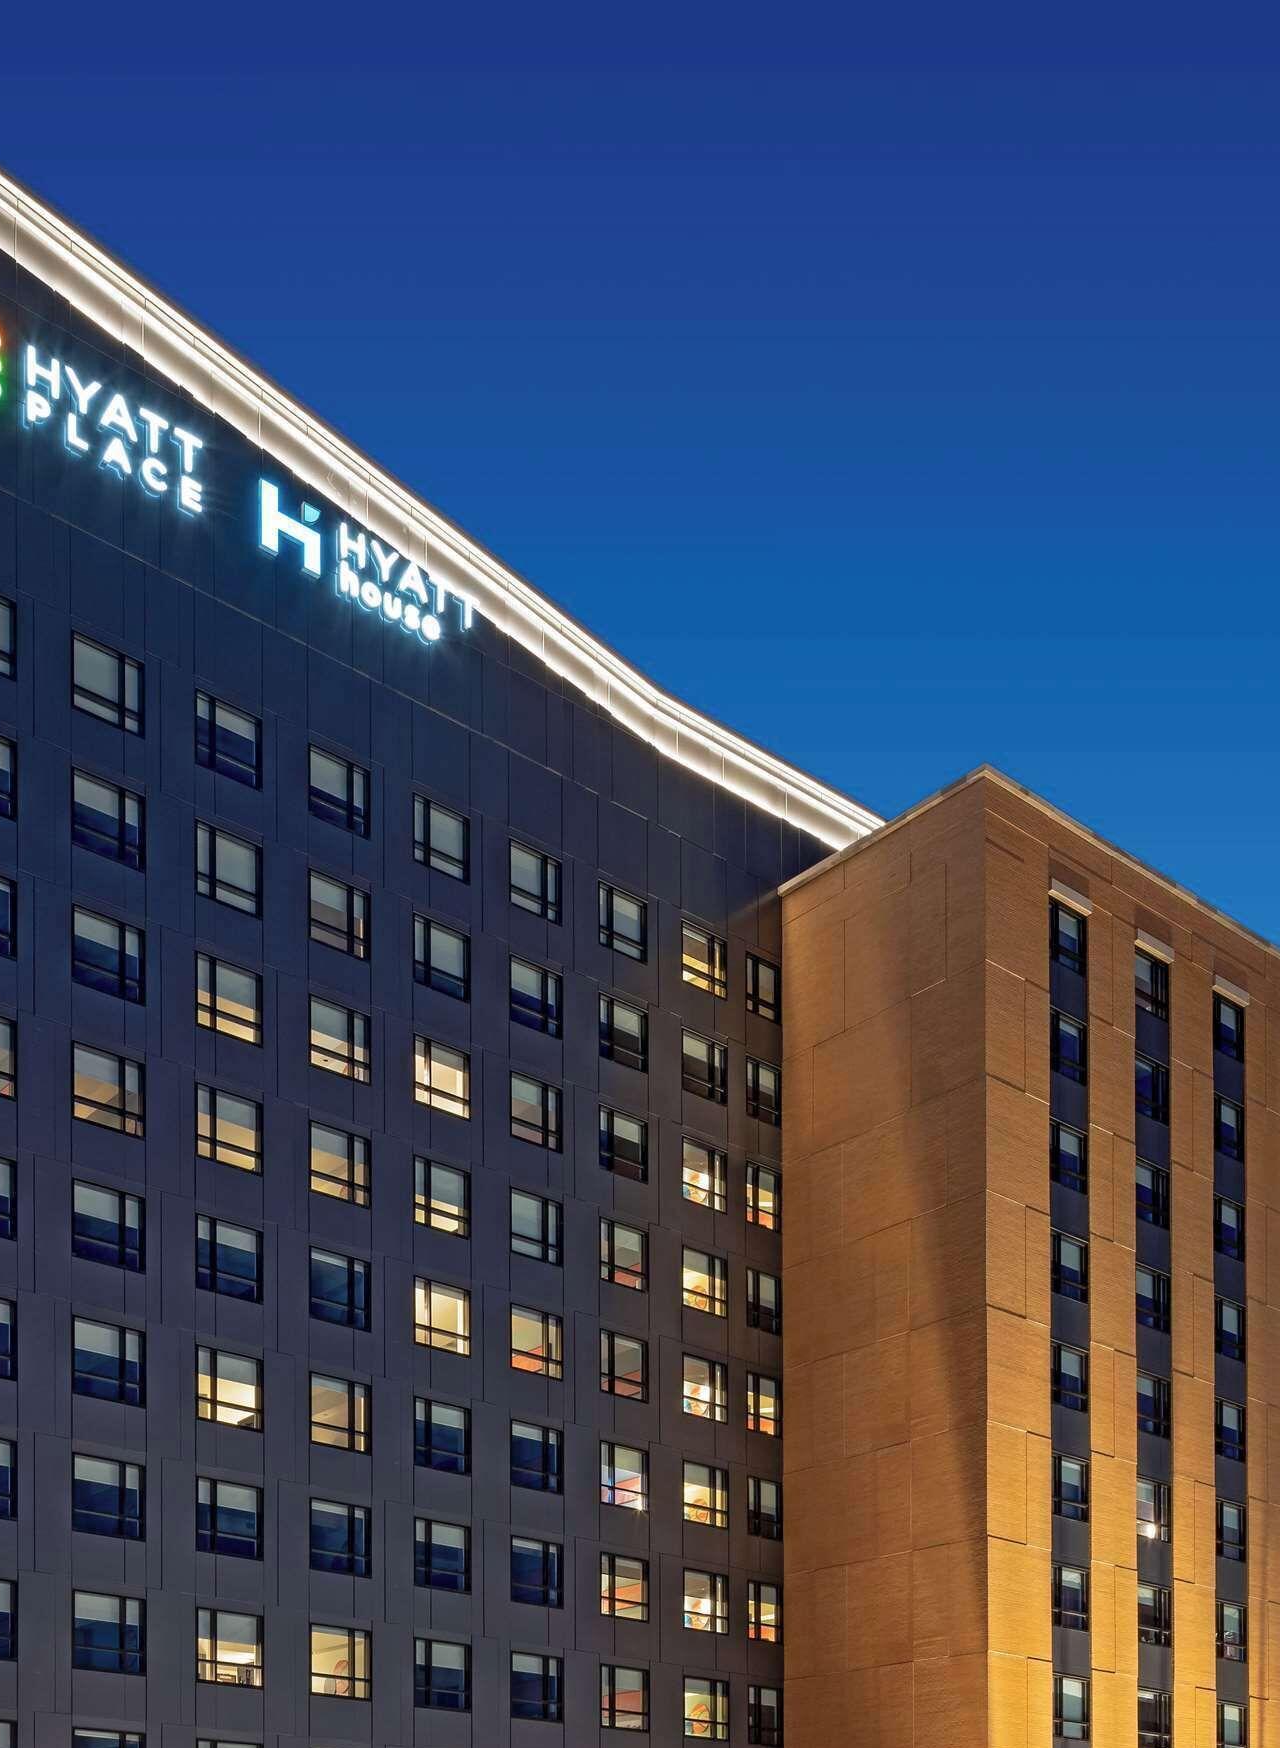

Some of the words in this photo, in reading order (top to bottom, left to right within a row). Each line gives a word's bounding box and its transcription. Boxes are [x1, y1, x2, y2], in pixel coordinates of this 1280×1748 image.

[23, 388, 204, 514] PLACE
[25, 344, 203, 473] HYATT
[336, 521, 481, 633] HYATT
